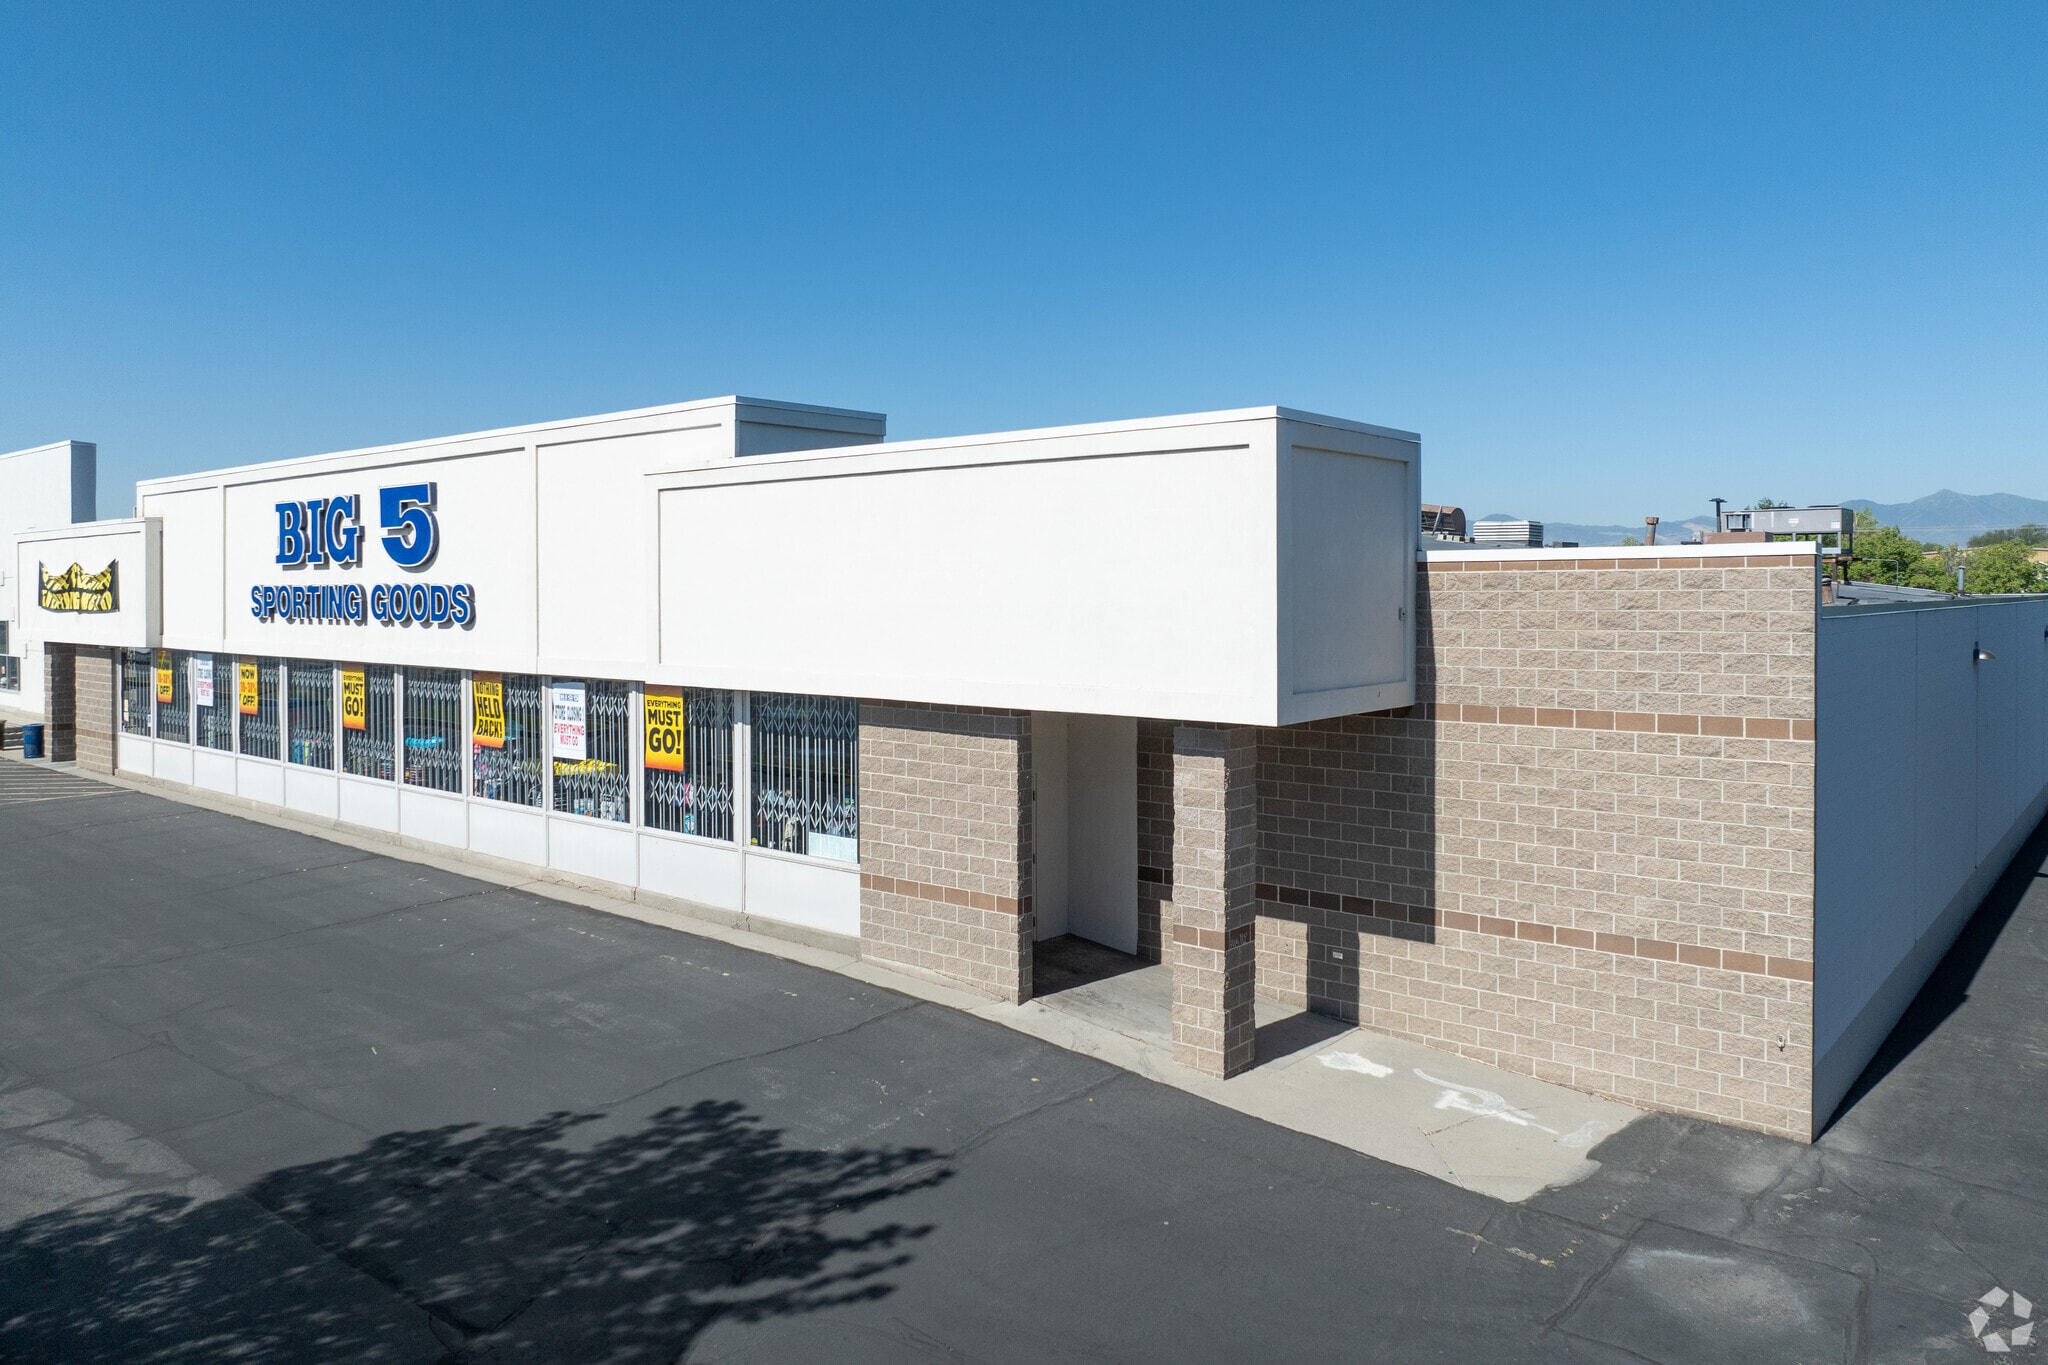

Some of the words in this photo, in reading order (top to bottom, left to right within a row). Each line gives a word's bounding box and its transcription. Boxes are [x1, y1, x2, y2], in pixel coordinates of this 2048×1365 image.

[275, 495, 360, 565] BIG
[379, 483, 435, 567] 5
[251, 584, 363, 622] SPORTING
[371, 583, 471, 624] GOODS
[241, 669, 255, 680] NOW
[344, 682, 363, 696] MUST
[476, 682, 499, 696] NOTHING
[243, 695, 256, 707] OFF!
[345, 696, 363, 717] GO!
[477, 696, 501, 719] HELD
[647, 699, 681, 709] EVERYTHING
[648, 709, 681, 727] MUST
[477, 718, 503, 739] BACK!
[554, 722, 585, 736] EVERYTHING
[649, 727, 682, 755] GO!
